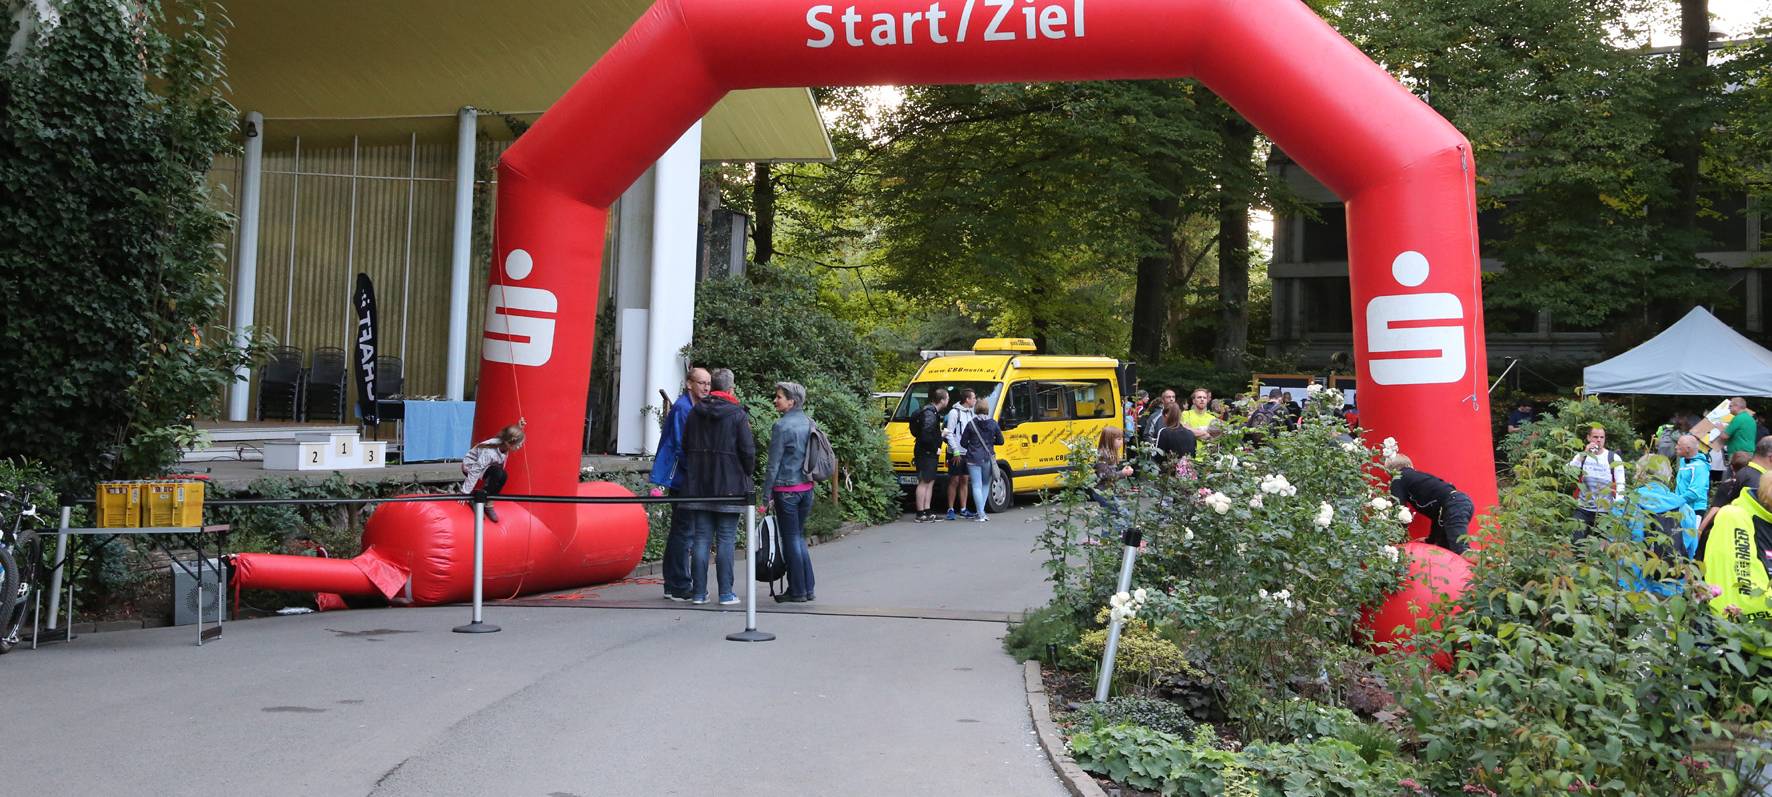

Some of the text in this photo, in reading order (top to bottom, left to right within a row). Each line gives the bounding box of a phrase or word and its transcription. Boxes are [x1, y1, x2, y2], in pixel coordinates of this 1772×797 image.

[806, 0, 1085, 48] Start/Ziel
[312, 442, 374, 463] 2 1 3
